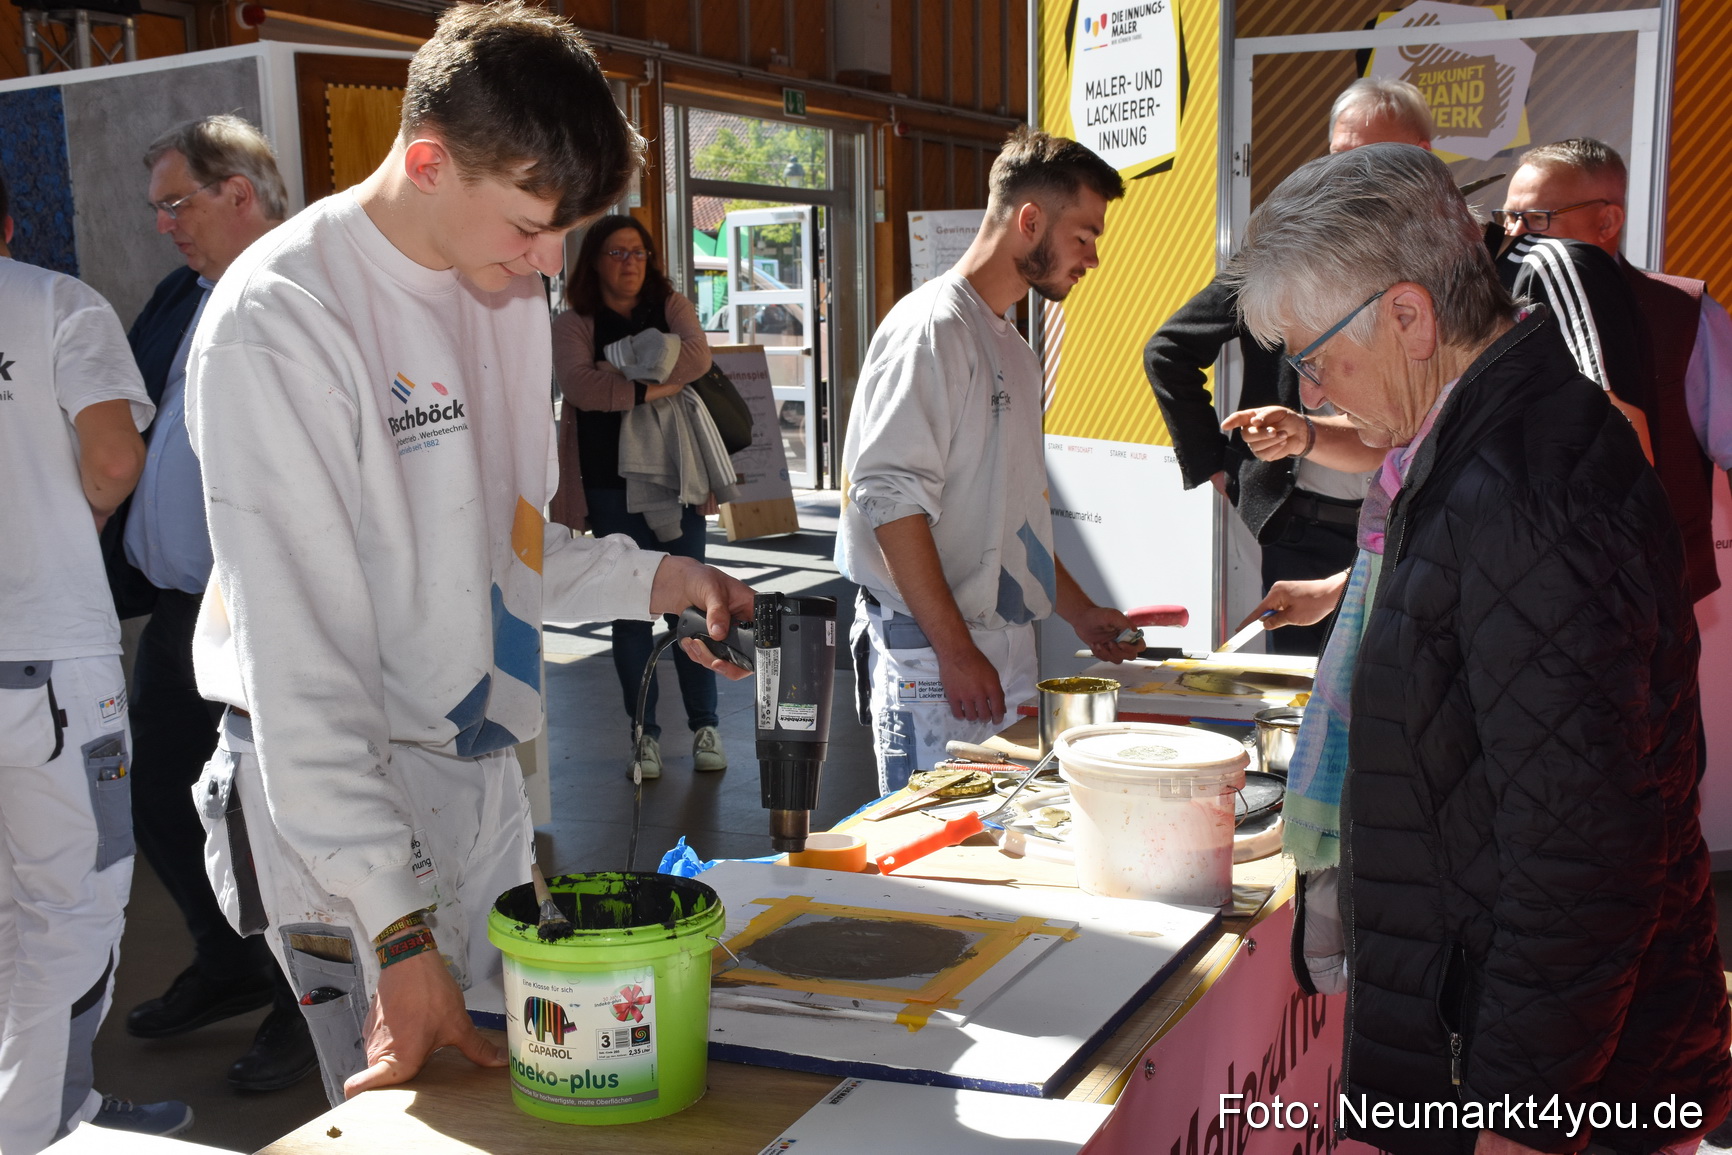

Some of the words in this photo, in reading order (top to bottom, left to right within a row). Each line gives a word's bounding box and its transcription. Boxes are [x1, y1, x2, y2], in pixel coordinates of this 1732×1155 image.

[1111, 10, 1124, 25] DIE
[1125, 1, 1166, 21] INNUNGS-
[1111, 21, 1138, 38] MALER
[1418, 64, 1486, 87] ZUKUNFT
[1085, 75, 1132, 101] MALER-
[1135, 68, 1163, 92] UND
[1087, 97, 1161, 127] LACKIERER-
[1098, 125, 1147, 151] INNUNG
[418, 423, 469, 440] Werbetechnik
[423, 439, 440, 449] 1882
[1109, 449, 1127, 459] STARKE
[1050, 507, 1103, 524] www.neumarkt.de
[522, 979, 532, 988] Eine
[532, 982, 550, 991] Klasse
[551, 984, 560, 992] für
[601, 1034, 611, 1049] 3
[528, 1043, 573, 1060] CAPAROL
[510, 1049, 619, 1095] Indeko-plus
[539, 1094, 577, 1106] hochwertigste,
[595, 1096, 633, 1106] Oberflächen
